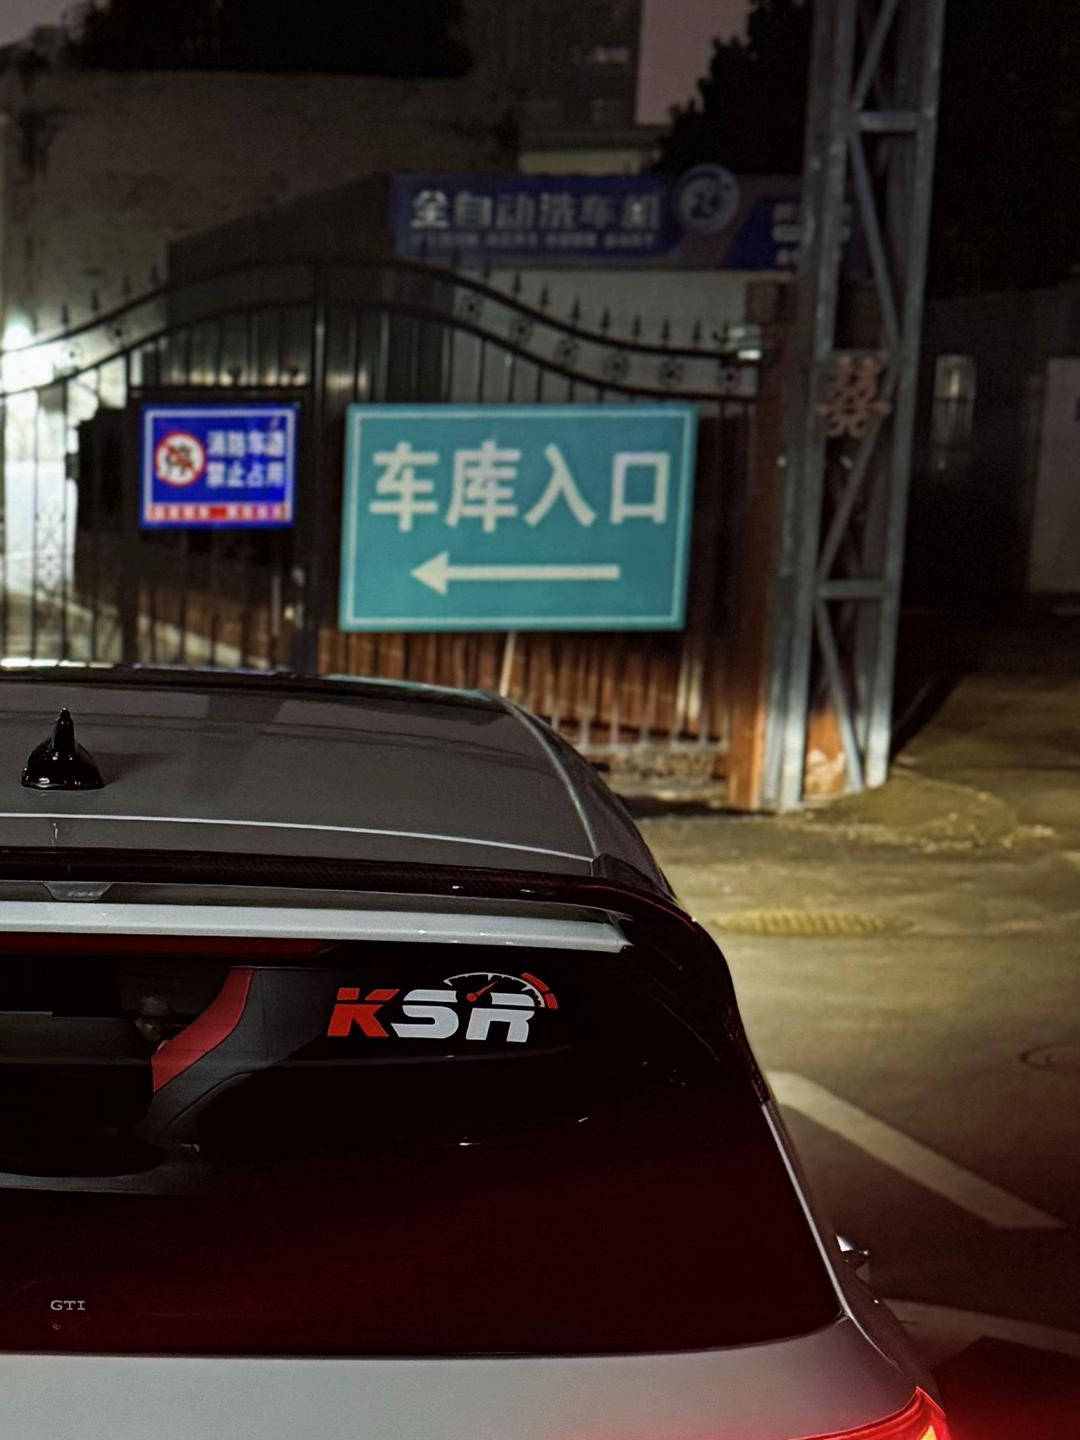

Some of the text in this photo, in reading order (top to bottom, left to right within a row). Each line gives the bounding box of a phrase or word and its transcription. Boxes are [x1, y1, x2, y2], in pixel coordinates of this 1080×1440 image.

[369, 440, 670, 533] 车库入口
[328, 986, 536, 1043] KSR
[50, 1300, 86, 1311] GTI
